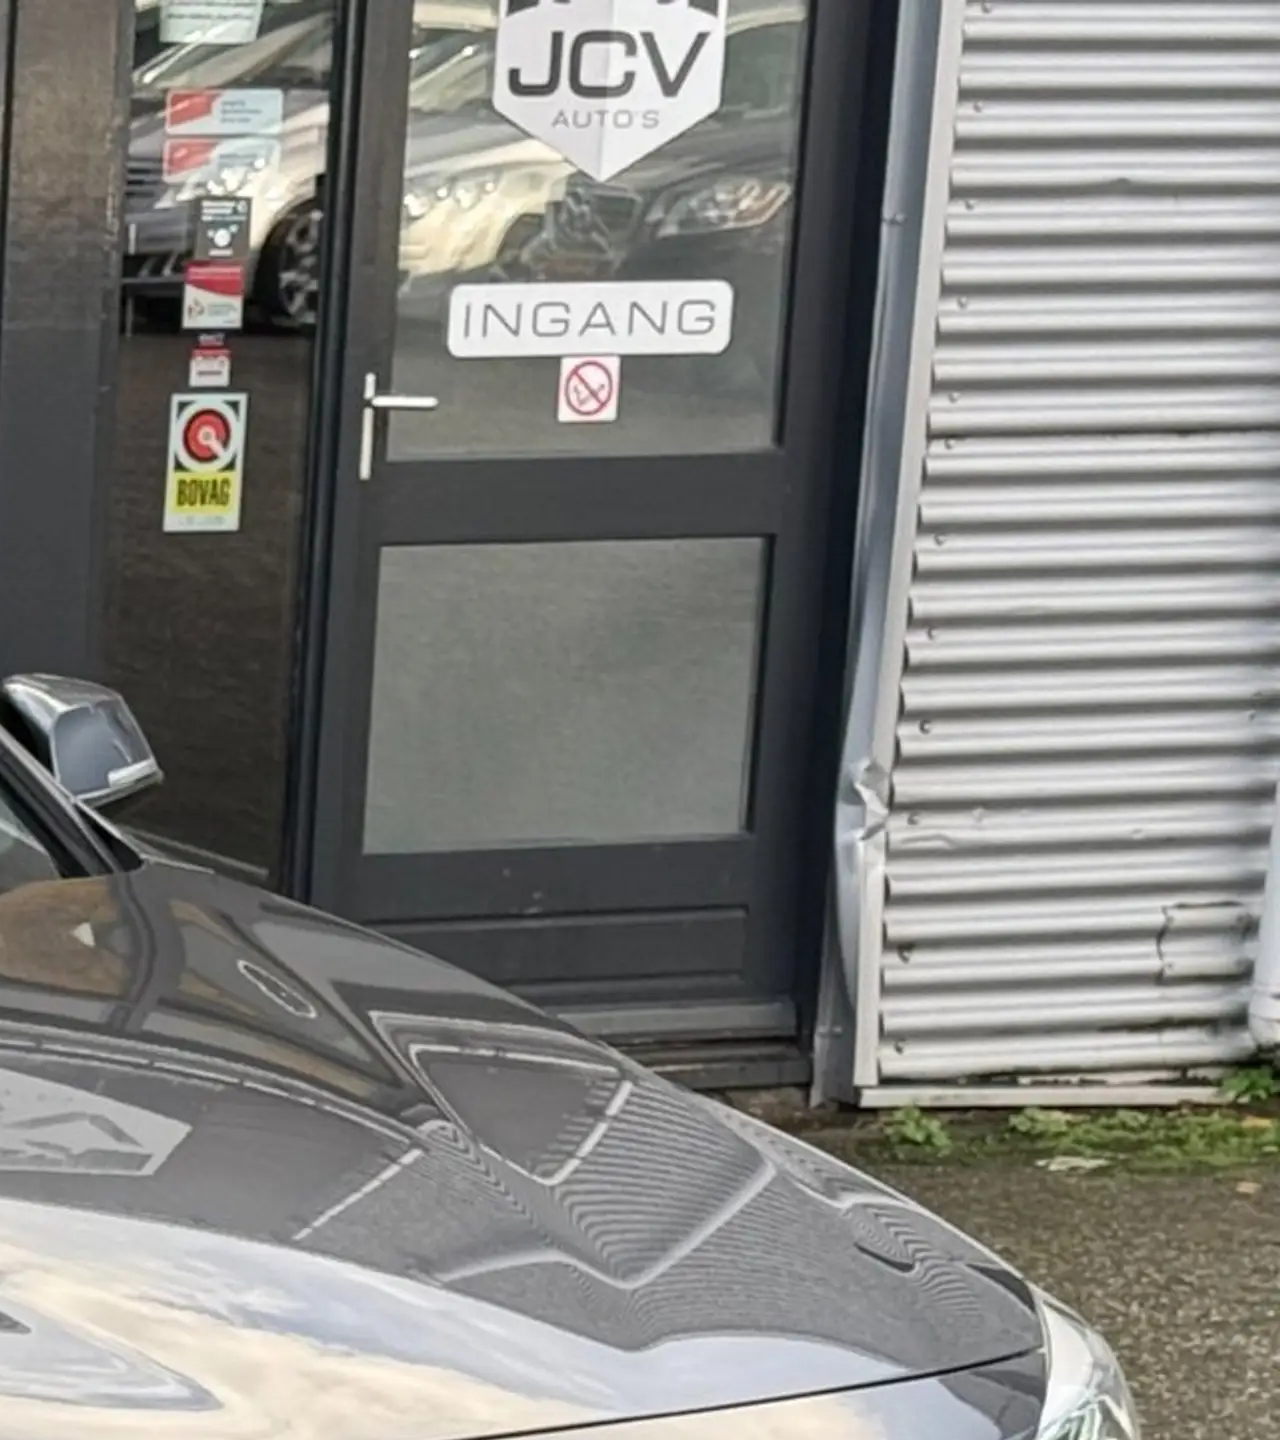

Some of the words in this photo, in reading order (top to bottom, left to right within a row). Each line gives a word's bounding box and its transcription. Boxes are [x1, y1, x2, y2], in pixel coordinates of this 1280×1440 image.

[508, 30, 711, 98] JCV
[464, 300, 716, 338] INGANG
[176, 477, 231, 507] BOVAG
